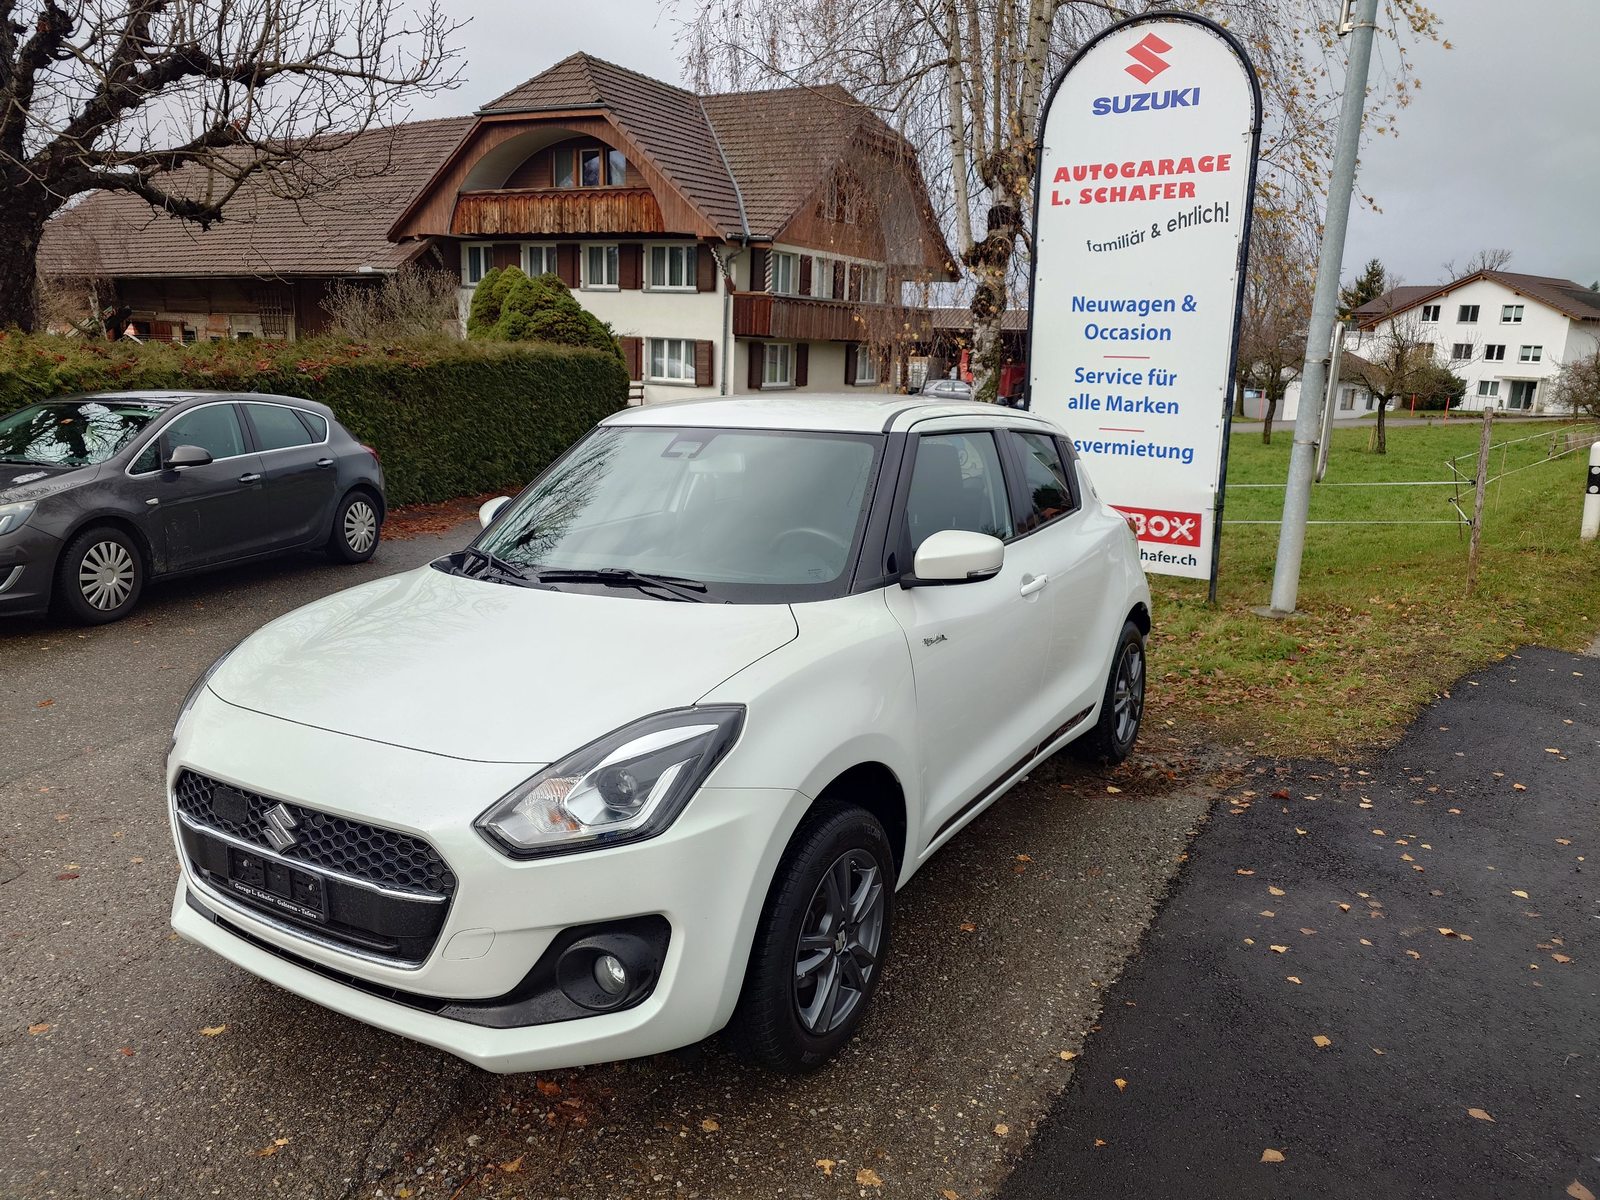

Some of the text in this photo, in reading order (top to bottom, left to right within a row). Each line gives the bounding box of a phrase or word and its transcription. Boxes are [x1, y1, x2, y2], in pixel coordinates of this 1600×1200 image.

[1092, 87, 1201, 116] SUZUKI
[1053, 154, 1232, 183] AUTOGARAGE
[1051, 181, 1196, 206] L. SCHAFER
[1086, 201, 1230, 252] familiär & ehrlich!
[1071, 294, 1197, 317] Neuwagen &
[1084, 323, 1171, 341] Occasion
[1074, 366, 1178, 386] Service für
[1068, 393, 1179, 415] alle Marken
